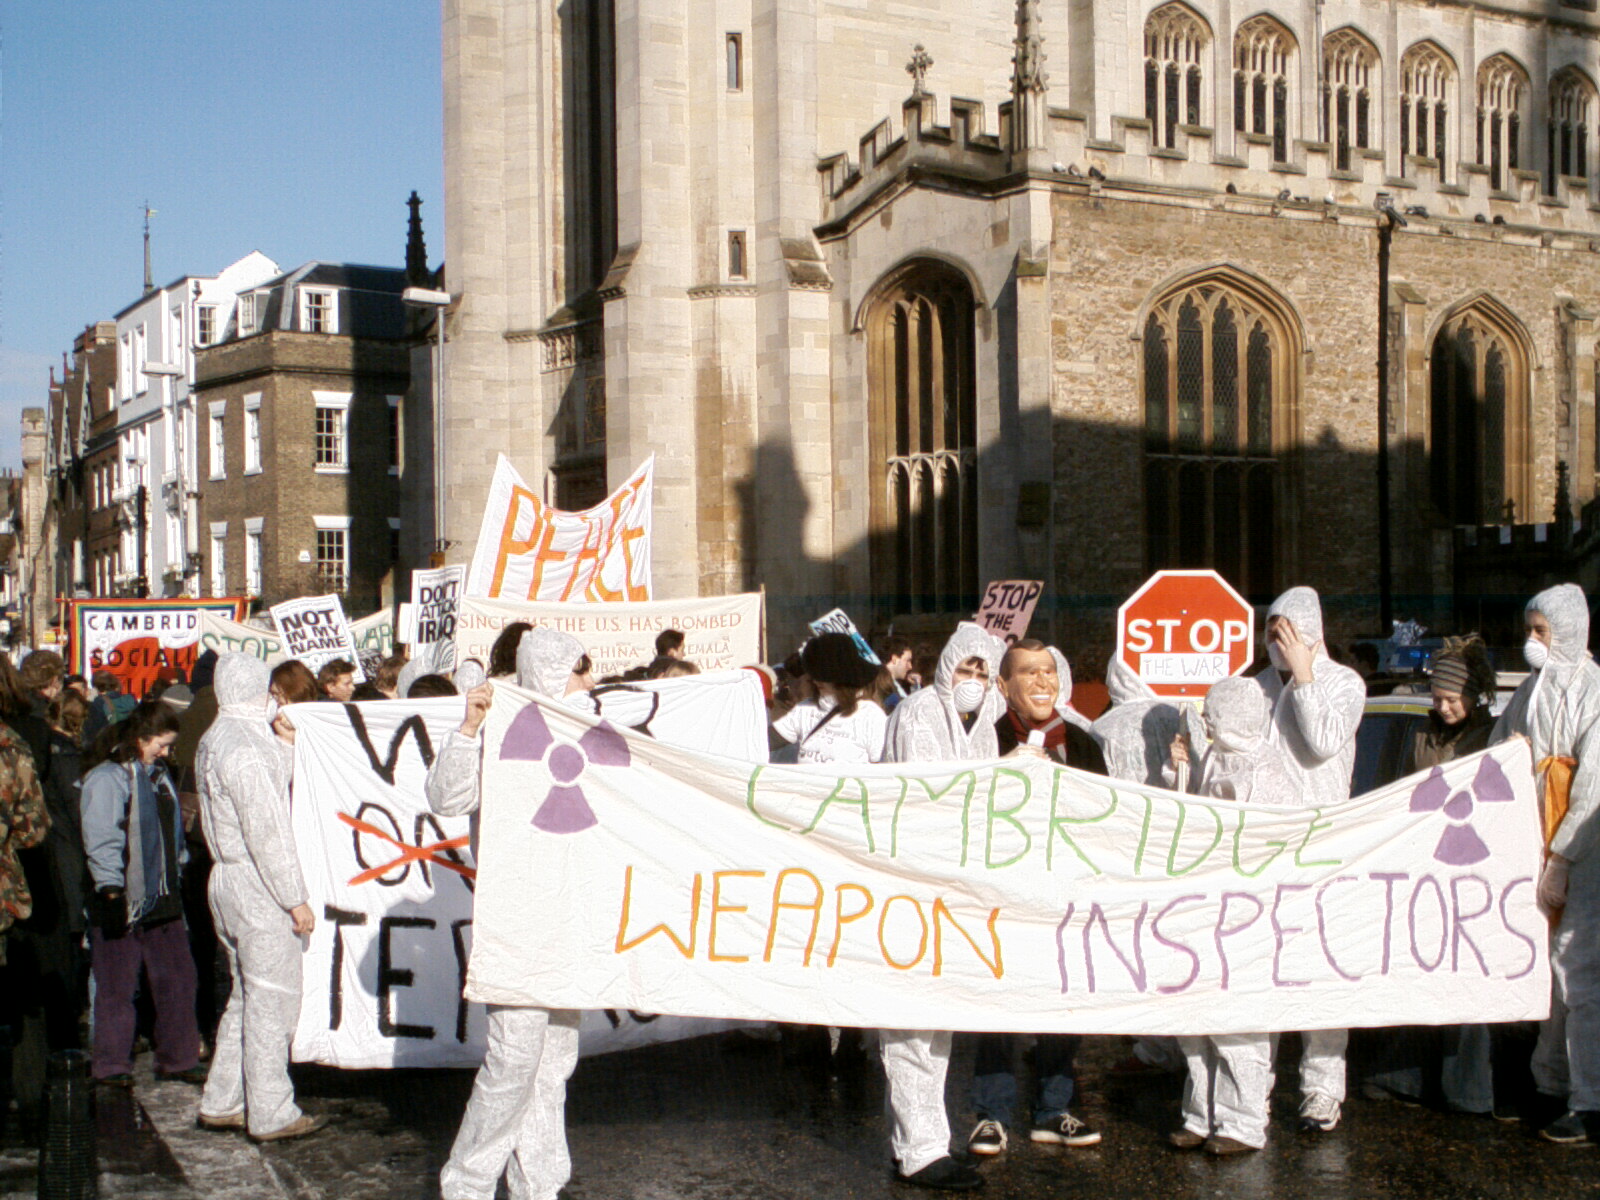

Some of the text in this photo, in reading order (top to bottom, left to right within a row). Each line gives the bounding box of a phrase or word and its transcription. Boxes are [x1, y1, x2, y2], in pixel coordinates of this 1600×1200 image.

[488, 475, 651, 601] PEACE
[983, 583, 1040, 612] STOP
[88, 614, 197, 631] CAMBRID
[280, 609, 335, 632] NOT
[459, 614, 504, 630] SINCE
[554, 617, 586, 632] THE
[595, 617, 622, 632] U.S.
[629, 616, 663, 632] HAS
[671, 613, 742, 630] BOMBED
[984, 614, 1016, 631] THE
[286, 624, 340, 644] IN MY
[1126, 619, 1248, 653] STOP
[201, 632, 282, 661] STOP
[290, 636, 348, 655] NAME
[588, 647, 639, 659] CHINA
[1143, 656, 1224, 677] THE WAR
[747, 765, 1342, 877] CAMBRIDGE
[614, 866, 1535, 993] WEAPON INSPECTORS
